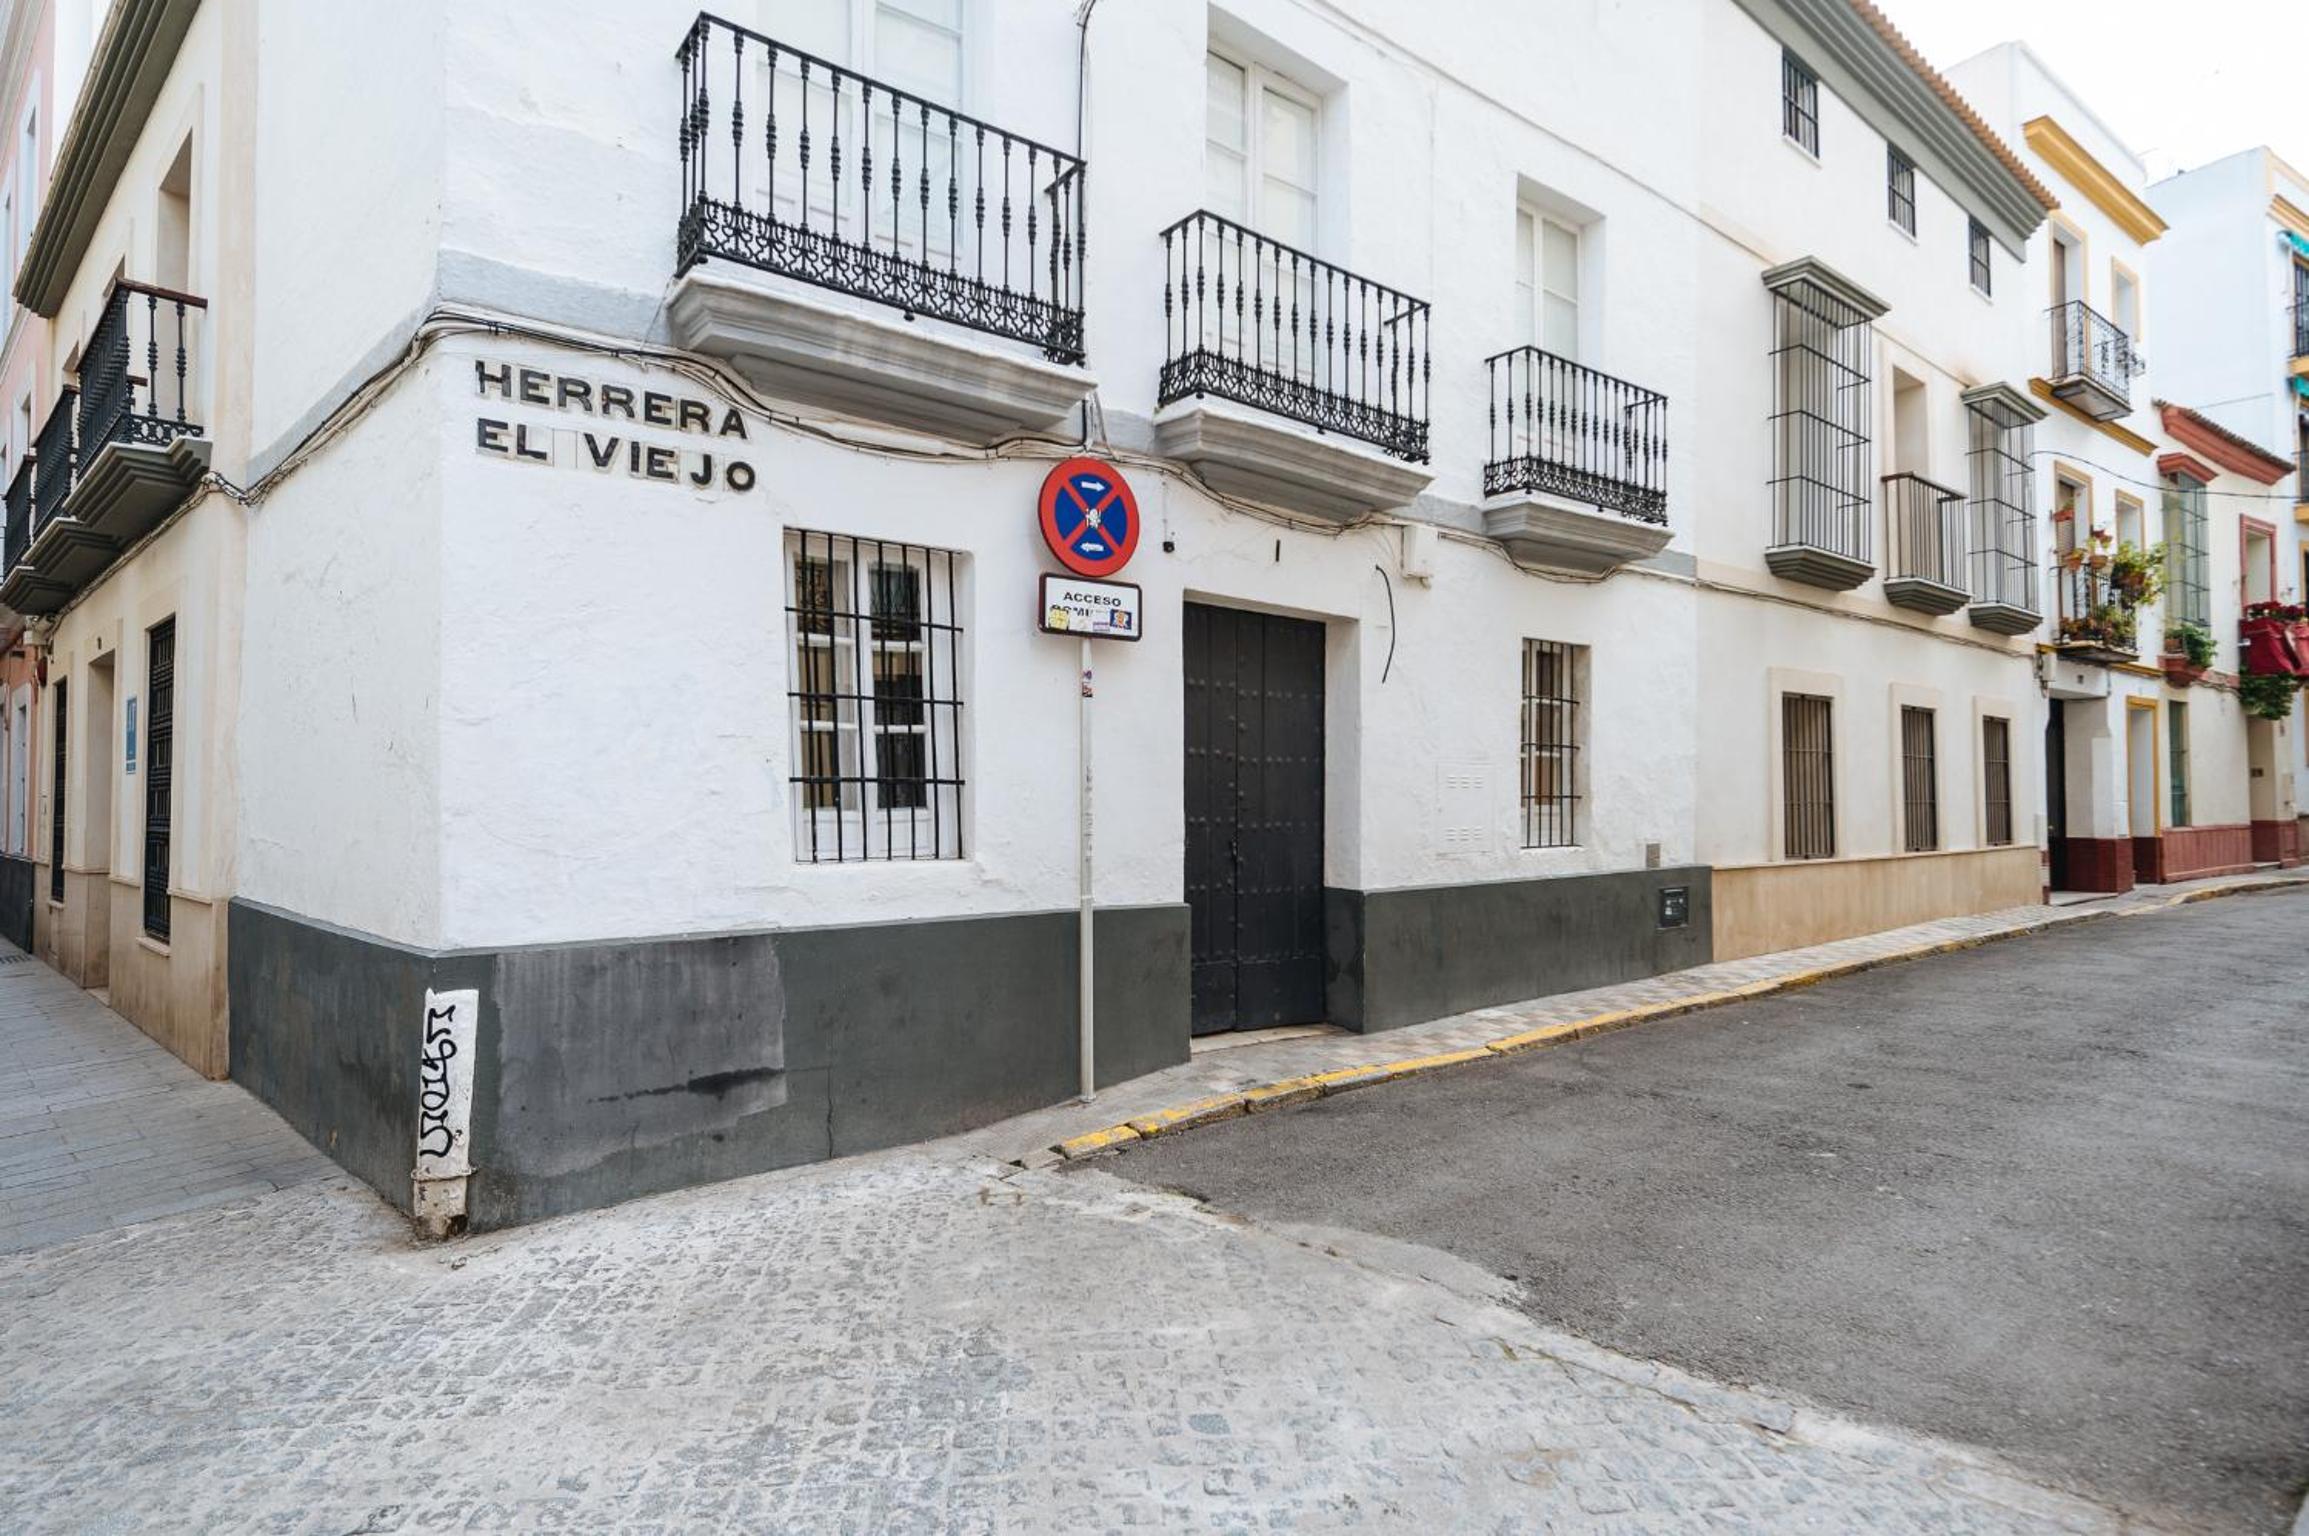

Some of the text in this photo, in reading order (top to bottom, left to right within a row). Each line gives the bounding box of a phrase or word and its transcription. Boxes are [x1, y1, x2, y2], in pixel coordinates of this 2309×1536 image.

[475, 360, 748, 439] HERRERA
[477, 418, 755, 491] EL VIEJO
[1063, 592, 1122, 607] ACCESO
